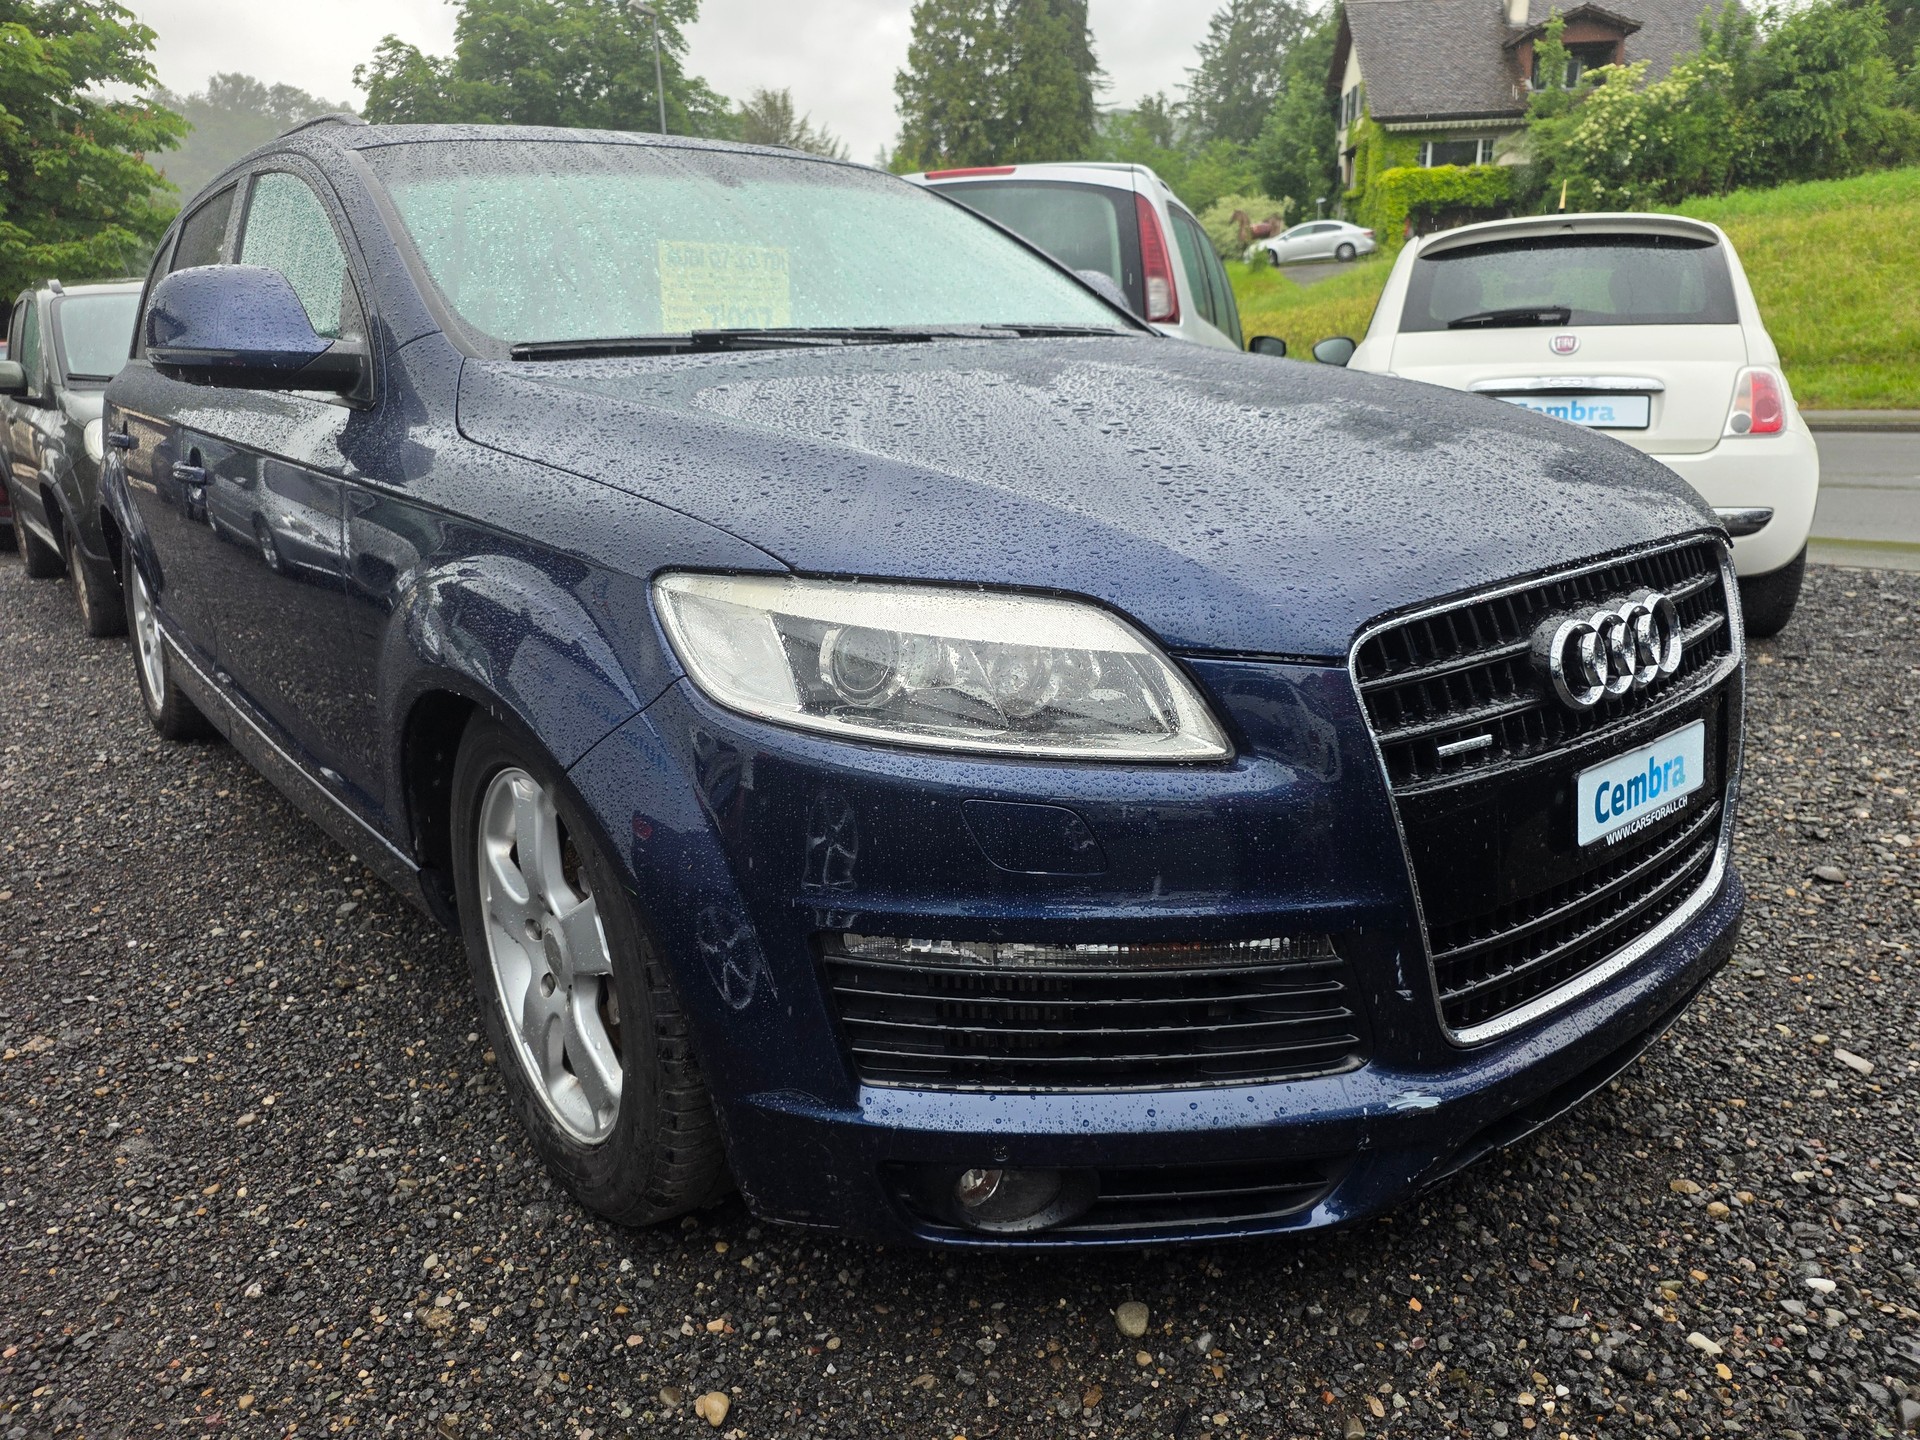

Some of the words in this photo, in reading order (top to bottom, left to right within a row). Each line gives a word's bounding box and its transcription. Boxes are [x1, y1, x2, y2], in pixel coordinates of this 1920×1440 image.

[1518, 400, 1616, 421] mbra
[1594, 755, 1686, 824] Cembra
[1606, 795, 1688, 846] WWW.CARSFORALL.CH
